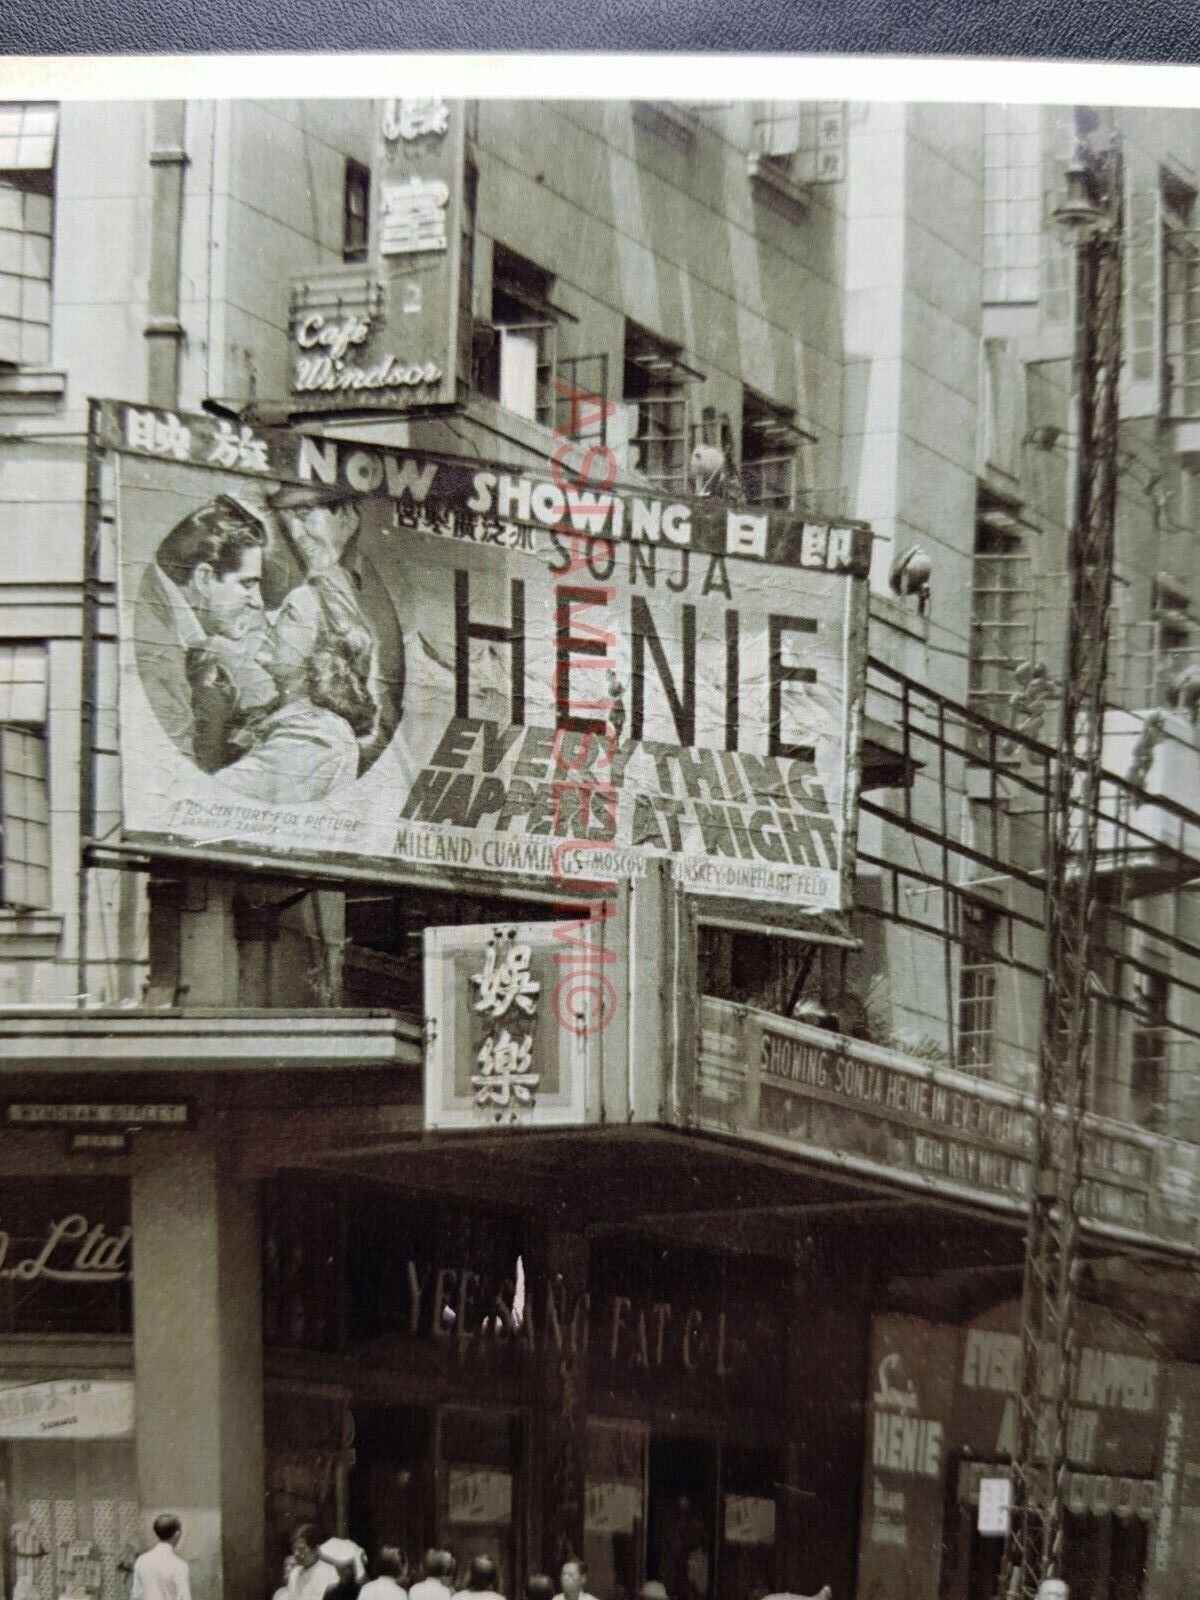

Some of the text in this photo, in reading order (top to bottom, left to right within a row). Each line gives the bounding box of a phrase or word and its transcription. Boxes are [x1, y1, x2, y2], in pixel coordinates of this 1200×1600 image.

[294, 355, 443, 391] Windsor
[298, 437, 693, 545] NOW SHOWING
[545, 530, 733, 600] SONJA
[454, 568, 818, 762] HENIE
[428, 717, 830, 814] EVERYTHING
[398, 768, 841, 872] HAPPENS AT NIGHT
[108, 1106, 179, 1121] STREET
[759, 1034, 828, 1088] SHOWING
[834, 1056, 883, 1103] SONJA
[886, 1072, 932, 1119] HENIE
